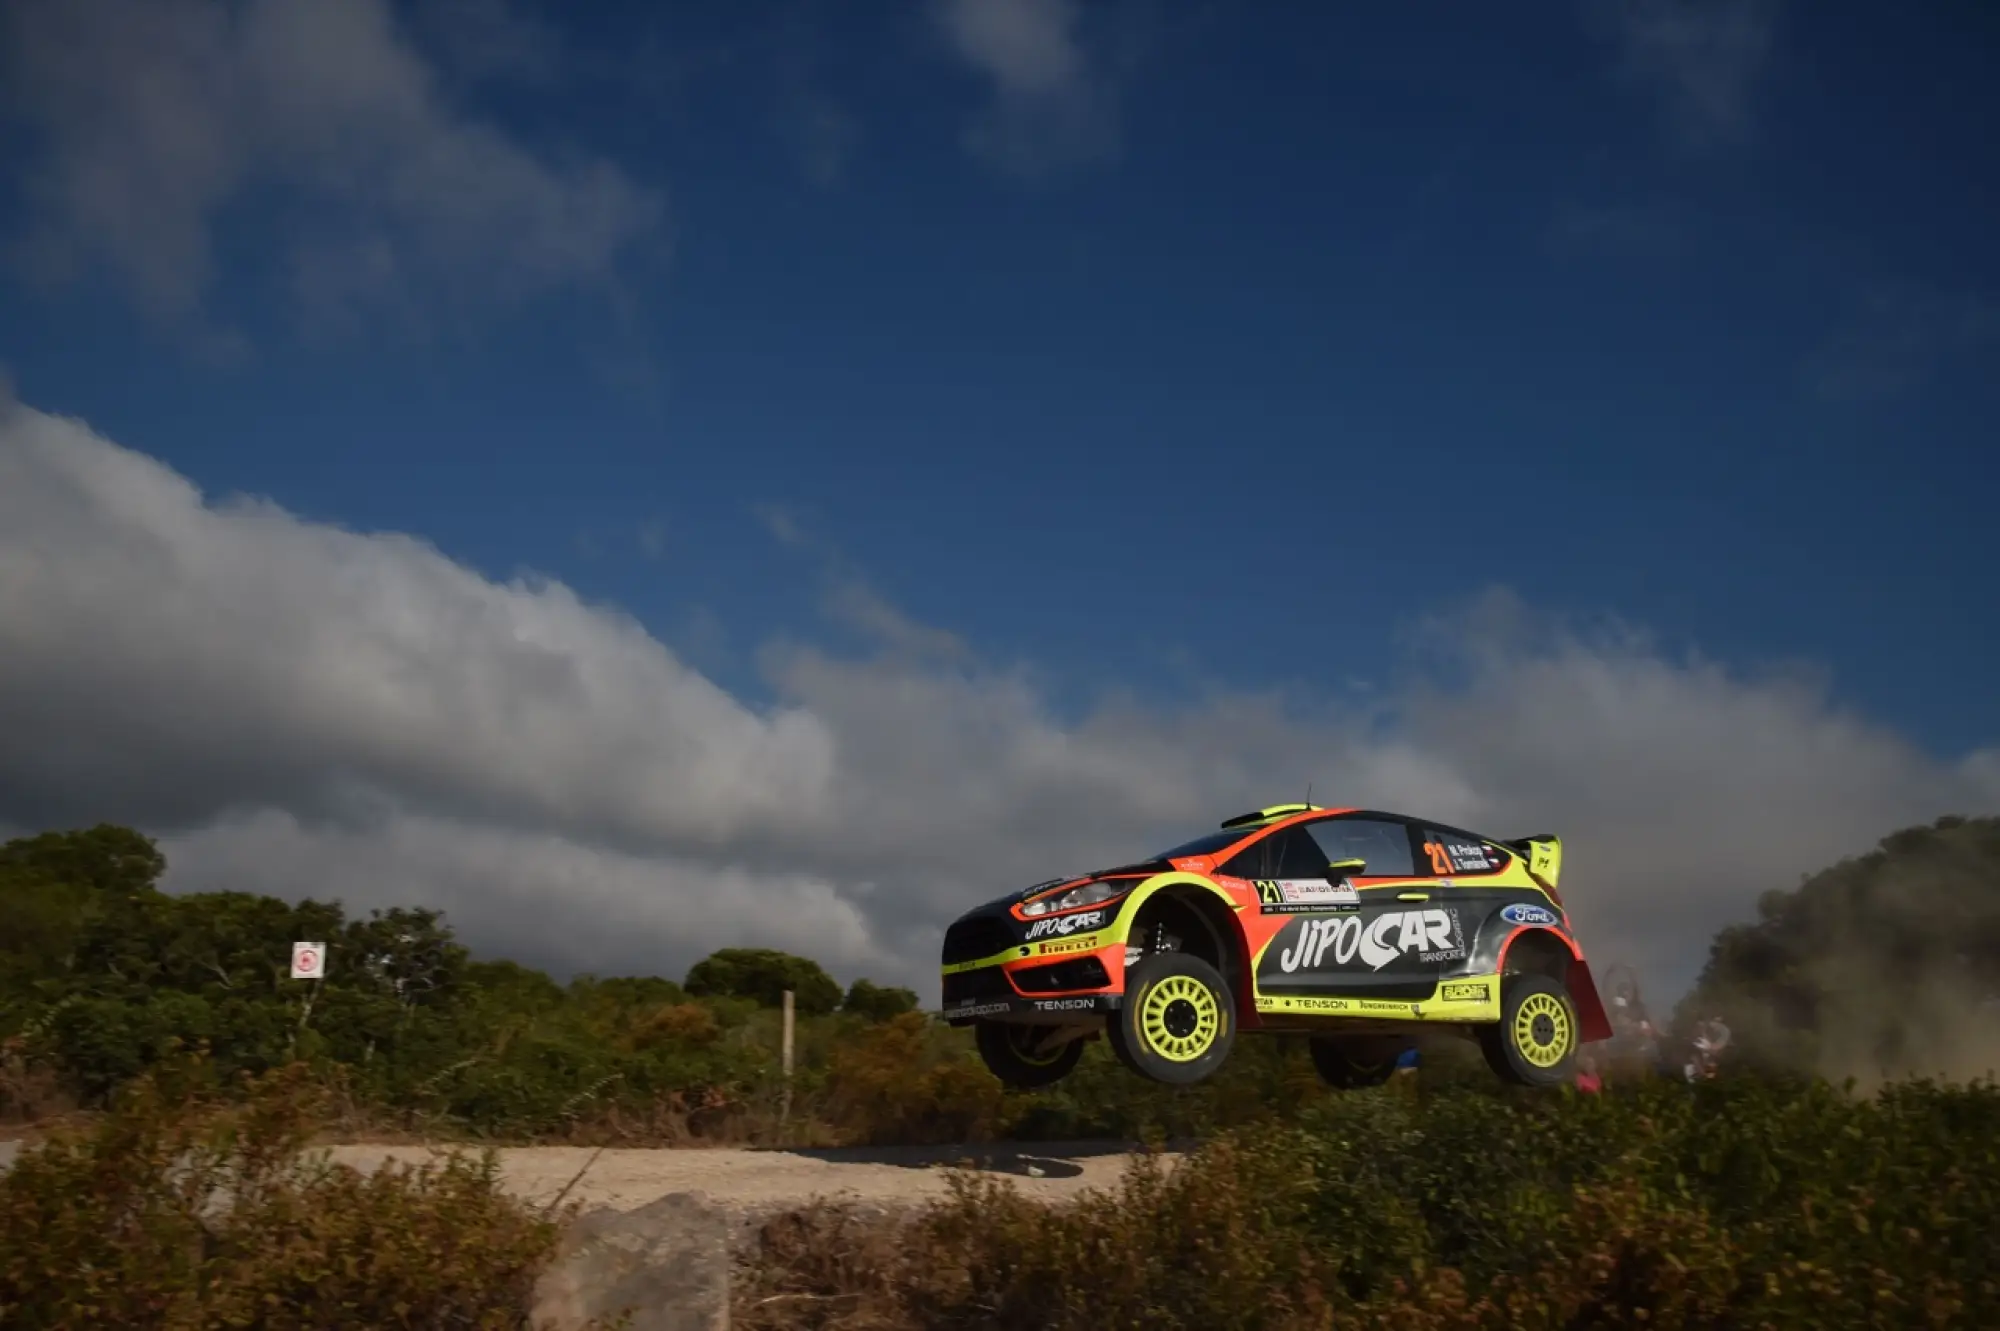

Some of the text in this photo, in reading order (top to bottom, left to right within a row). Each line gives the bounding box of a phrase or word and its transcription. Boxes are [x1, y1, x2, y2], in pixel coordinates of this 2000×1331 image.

[1423, 842, 1455, 874] 21
[1257, 880, 1281, 903] 21
[1515, 908, 1549, 921] Ford
[1039, 936, 1097, 955] PIRELLI
[1419, 949, 1460, 962] TRANSPORT
[1034, 999, 1095, 1010] TENSON
[1296, 999, 1348, 1009] TENSON
